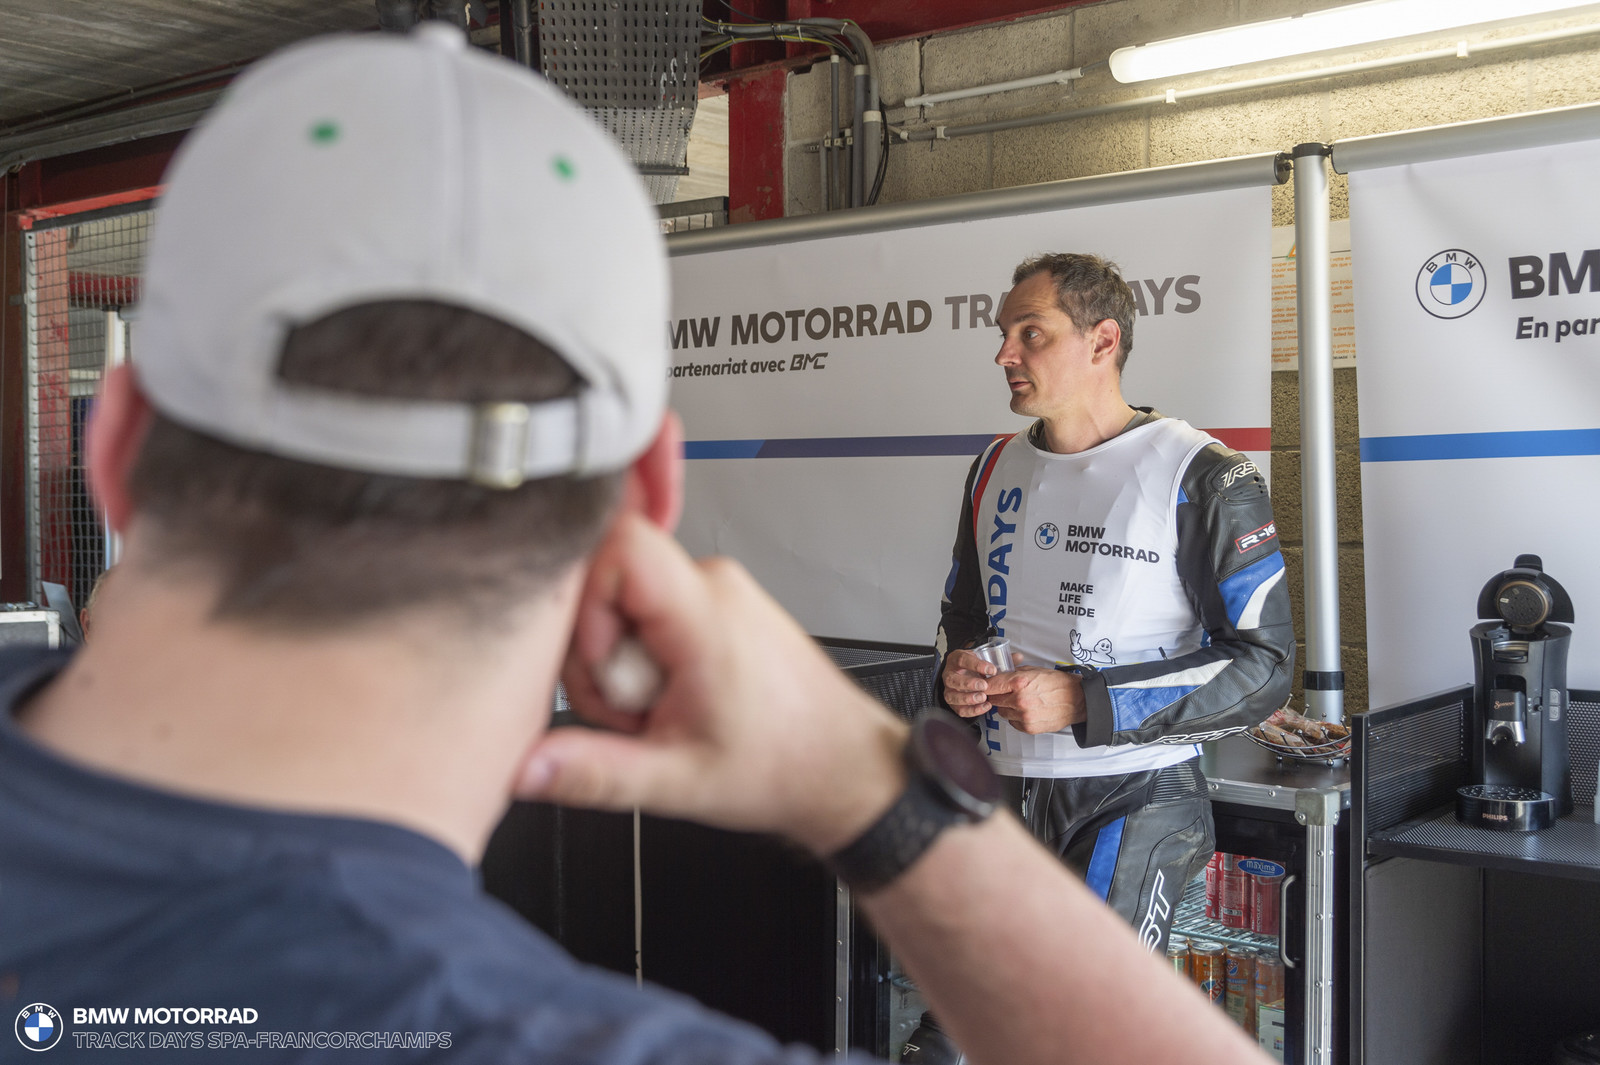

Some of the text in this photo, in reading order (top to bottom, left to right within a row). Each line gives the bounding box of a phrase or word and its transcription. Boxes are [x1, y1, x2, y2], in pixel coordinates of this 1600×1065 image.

[1425, 252, 1477, 274] BMW
[1508, 249, 1600, 299] BM
[667, 317, 721, 350] MW
[731, 299, 932, 346] MOTORRAD
[1126, 275, 1202, 316] AYS
[1516, 316, 1600, 343] En par
[750, 359, 786, 374] avec
[789, 352, 828, 371] BMC
[1221, 461, 1259, 488] RS
[1067, 524, 1106, 539] BMW
[1240, 523, 1276, 549] R-16
[1065, 539, 1160, 564] MOTORRAD
[1058, 593, 1082, 604] LIFE
[1060, 581, 1094, 594] MAKE
[1057, 604, 1096, 618] A RIDE
[1482, 812, 1508, 821] PHILIPS
[1137, 868, 1171, 956] ST
